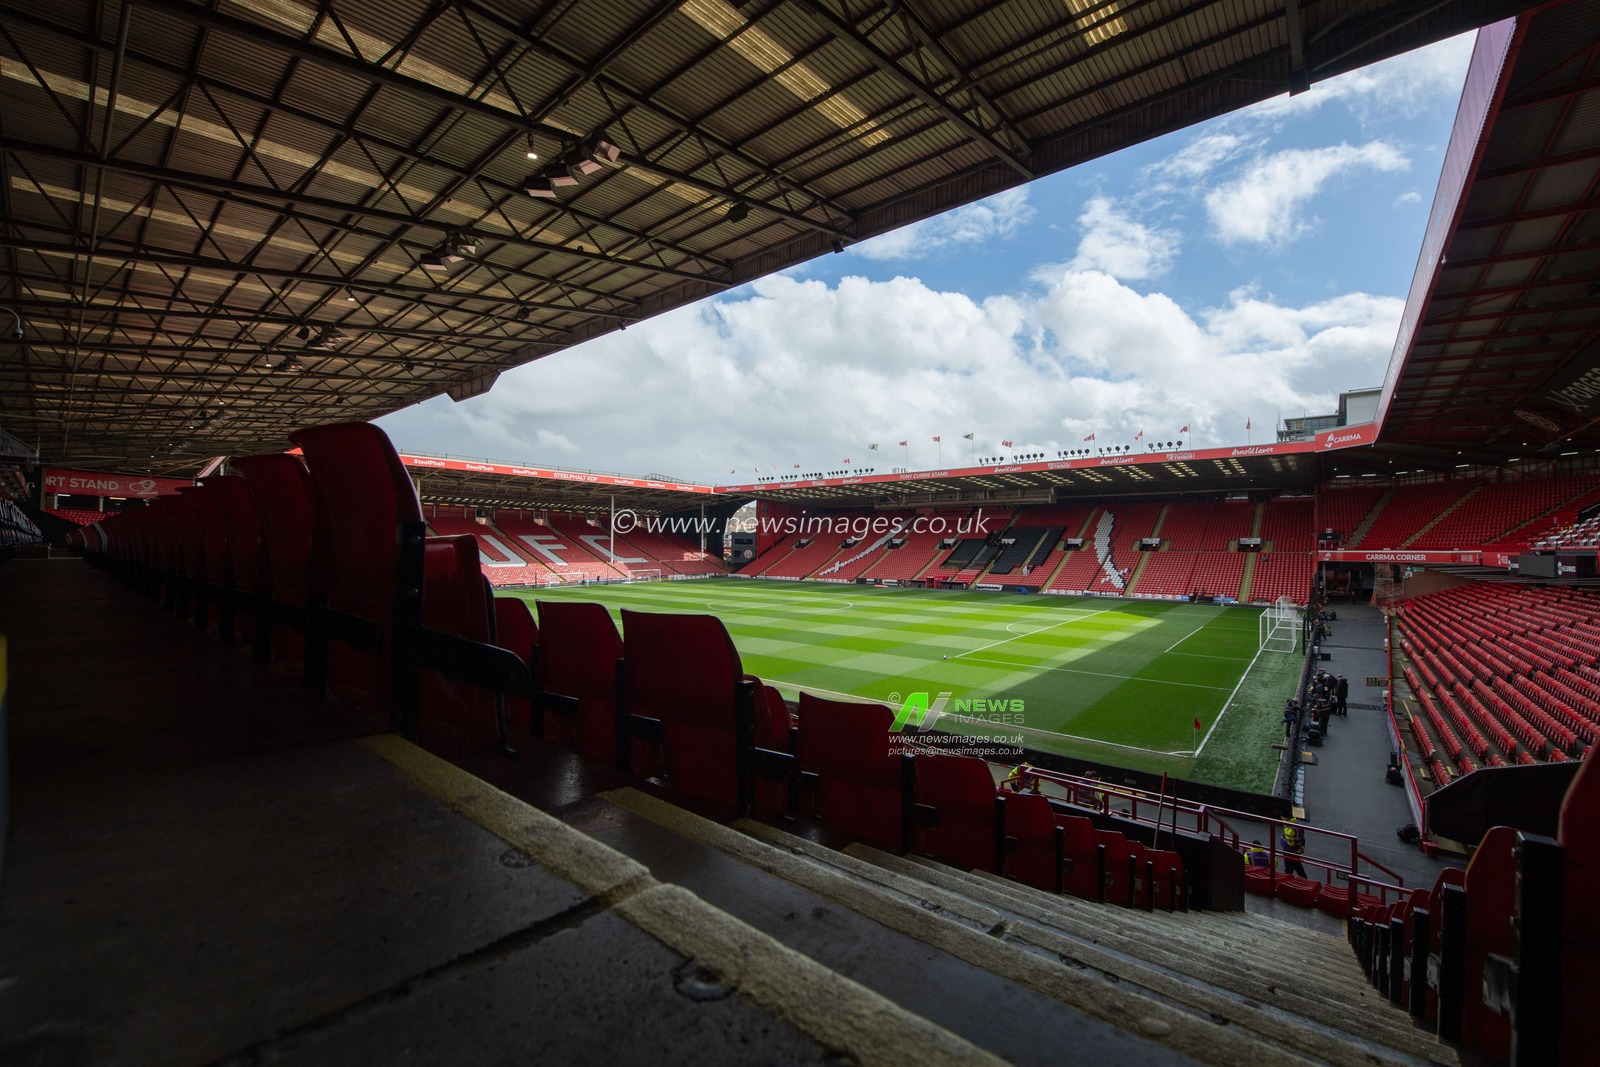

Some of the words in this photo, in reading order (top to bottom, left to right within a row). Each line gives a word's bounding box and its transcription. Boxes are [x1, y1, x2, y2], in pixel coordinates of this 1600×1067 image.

[1333, 433, 1361, 444] CARRMA
[1231, 447, 1254, 456] Arnold
[413, 459, 446, 467] SteelPhalt
[465, 463, 494, 472] SteelPhalt
[553, 472, 587, 481] STEELPHALT
[69, 477, 119, 491] STAND
[1365, 553, 1395, 561] CARRMA
[1396, 553, 1427, 561] CORNER
